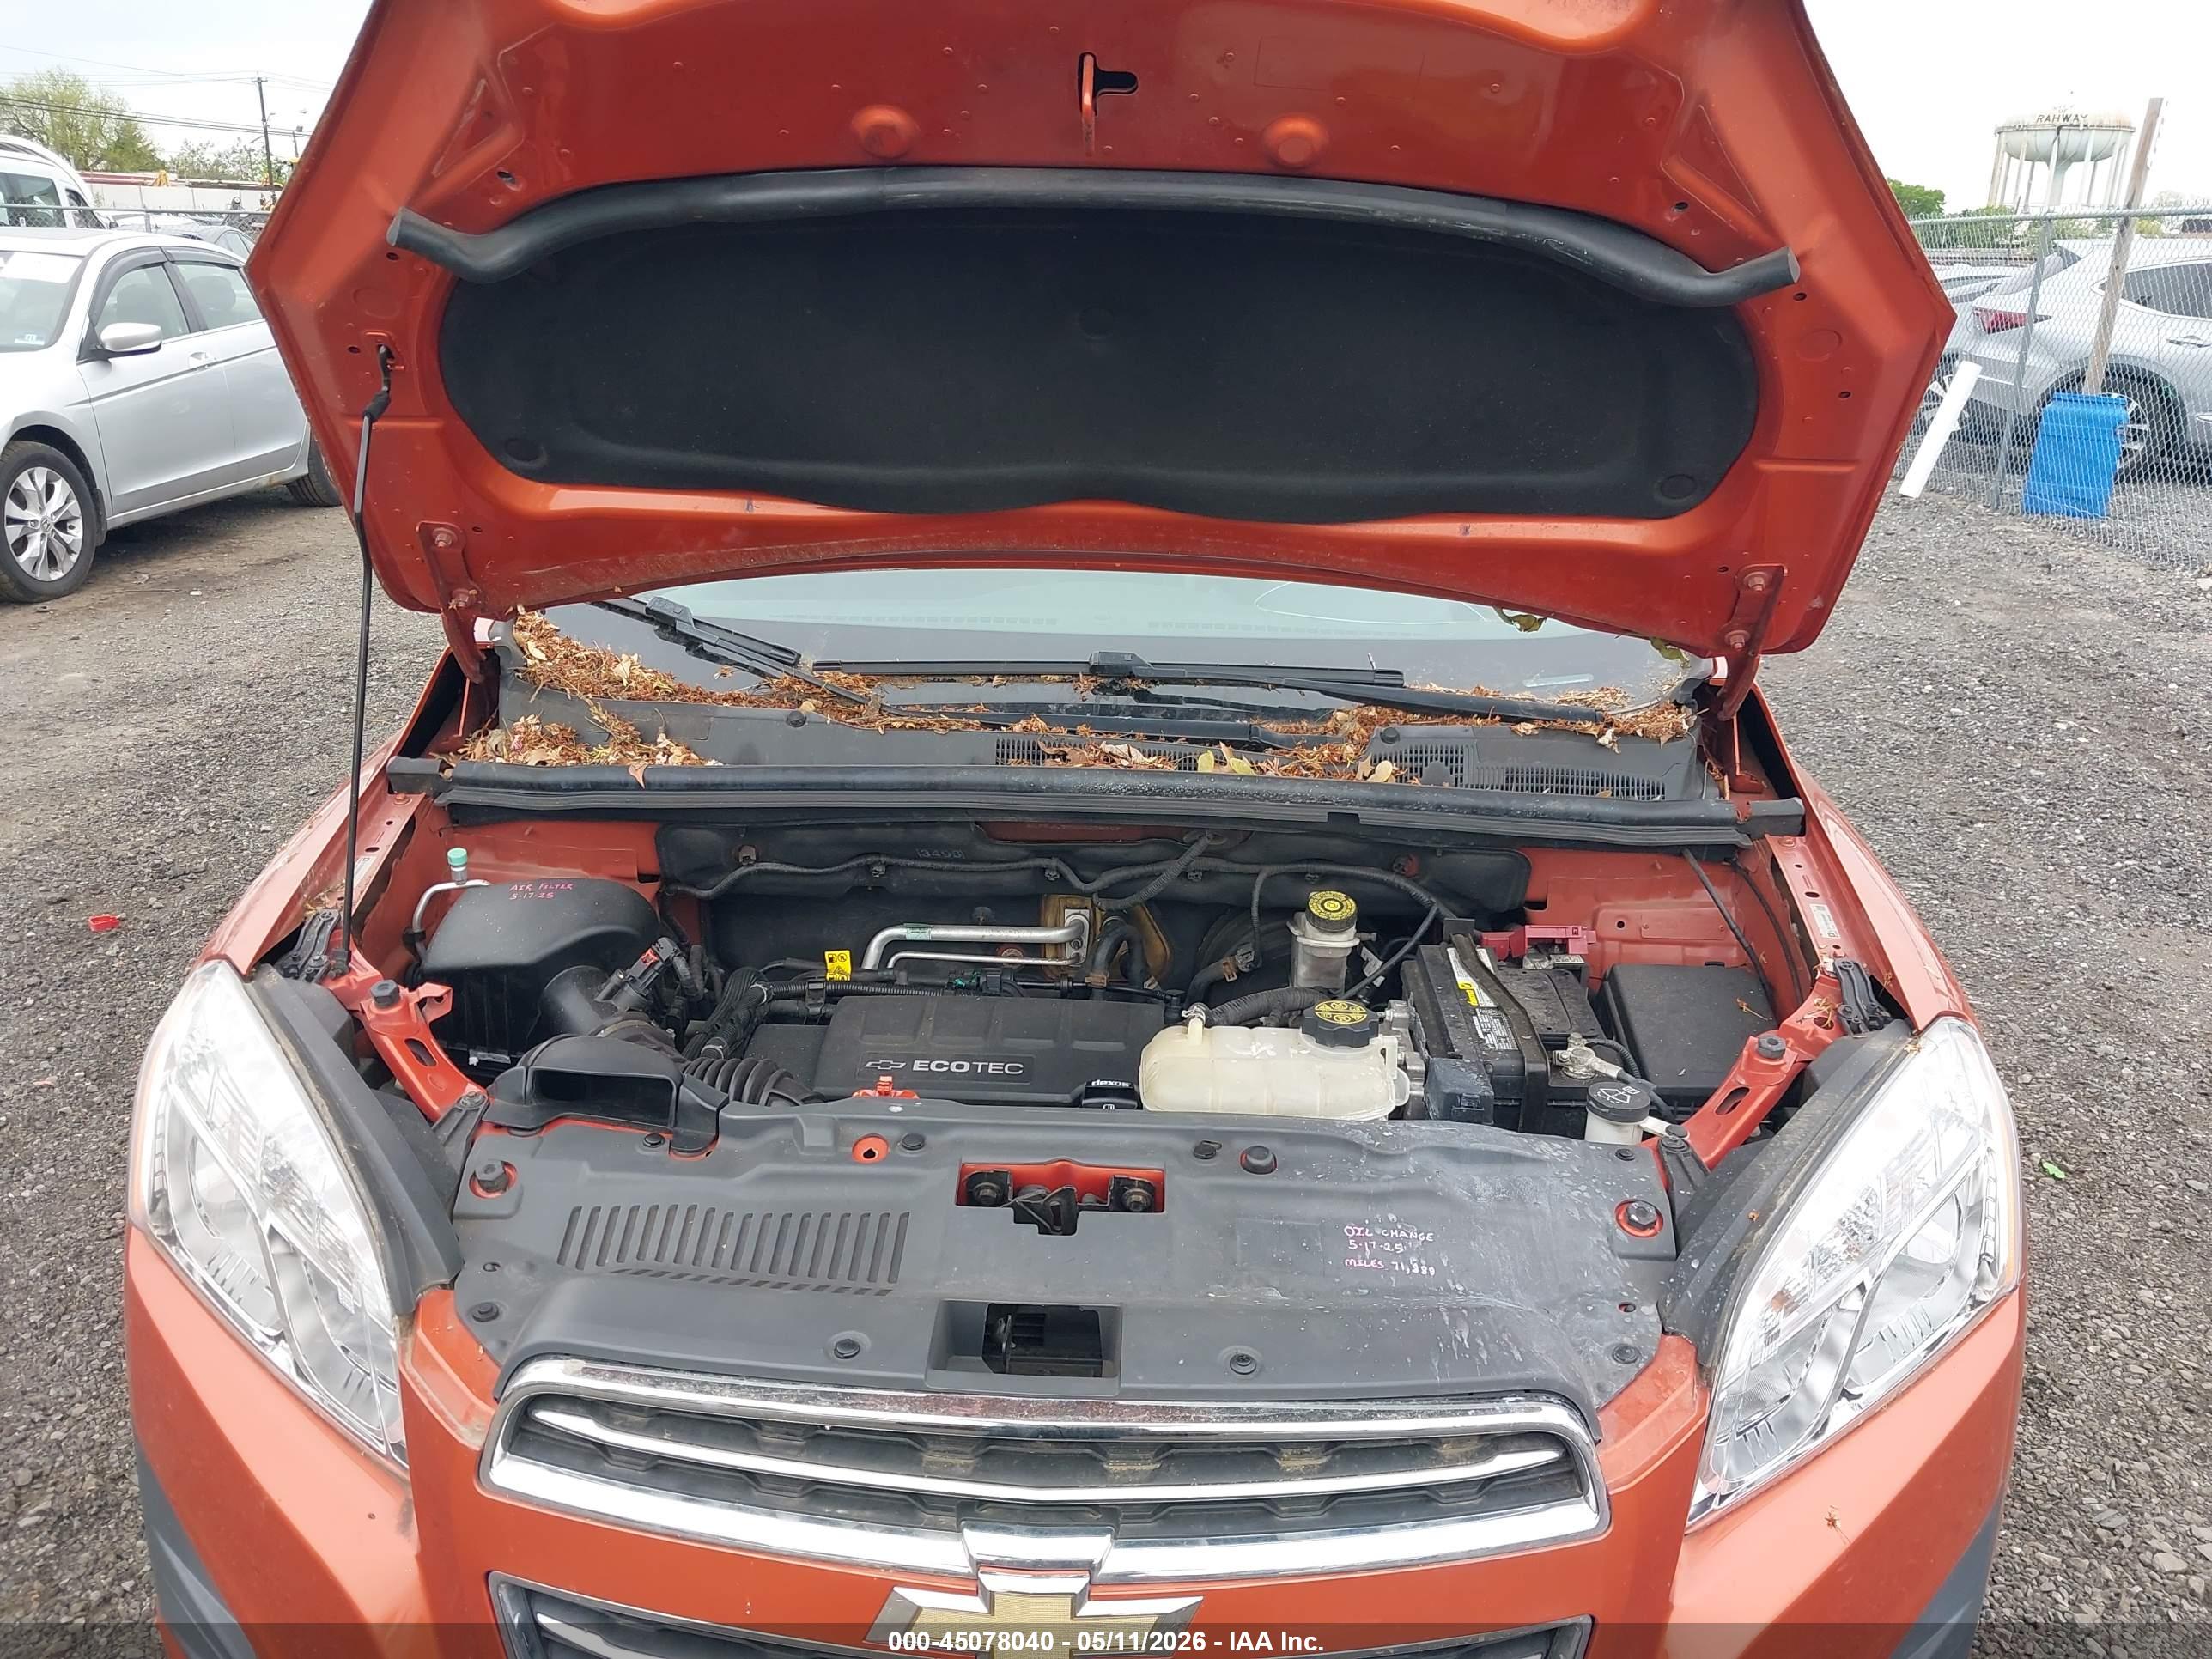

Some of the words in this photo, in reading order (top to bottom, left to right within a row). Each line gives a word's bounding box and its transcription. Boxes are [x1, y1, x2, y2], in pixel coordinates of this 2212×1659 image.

[2036, 113, 2088, 123] RAHWAY
[912, 1060, 1024, 1074] ECOTEC
[1344, 1225, 1373, 1237] OIL
[1381, 1229, 1434, 1242] CHANGE
